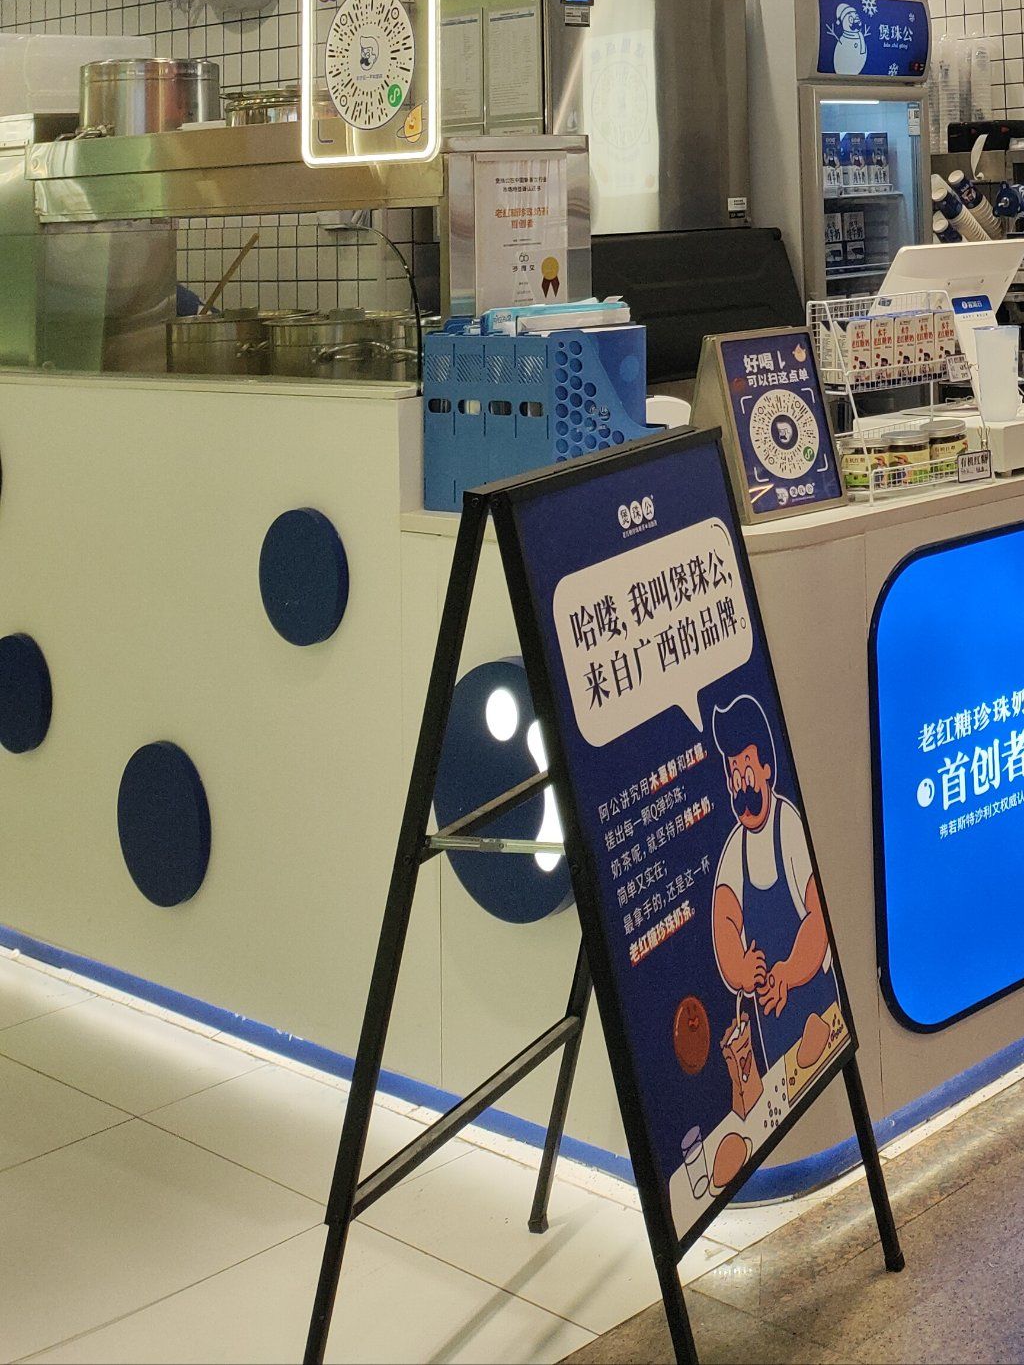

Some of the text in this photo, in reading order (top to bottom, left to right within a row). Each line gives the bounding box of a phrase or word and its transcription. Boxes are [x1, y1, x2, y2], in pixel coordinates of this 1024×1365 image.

[879, 24, 914, 42] 煲珠公
[746, 368, 809, 387] 可以扫这点单
[583, 596, 747, 711] 来自广西的品牌。
